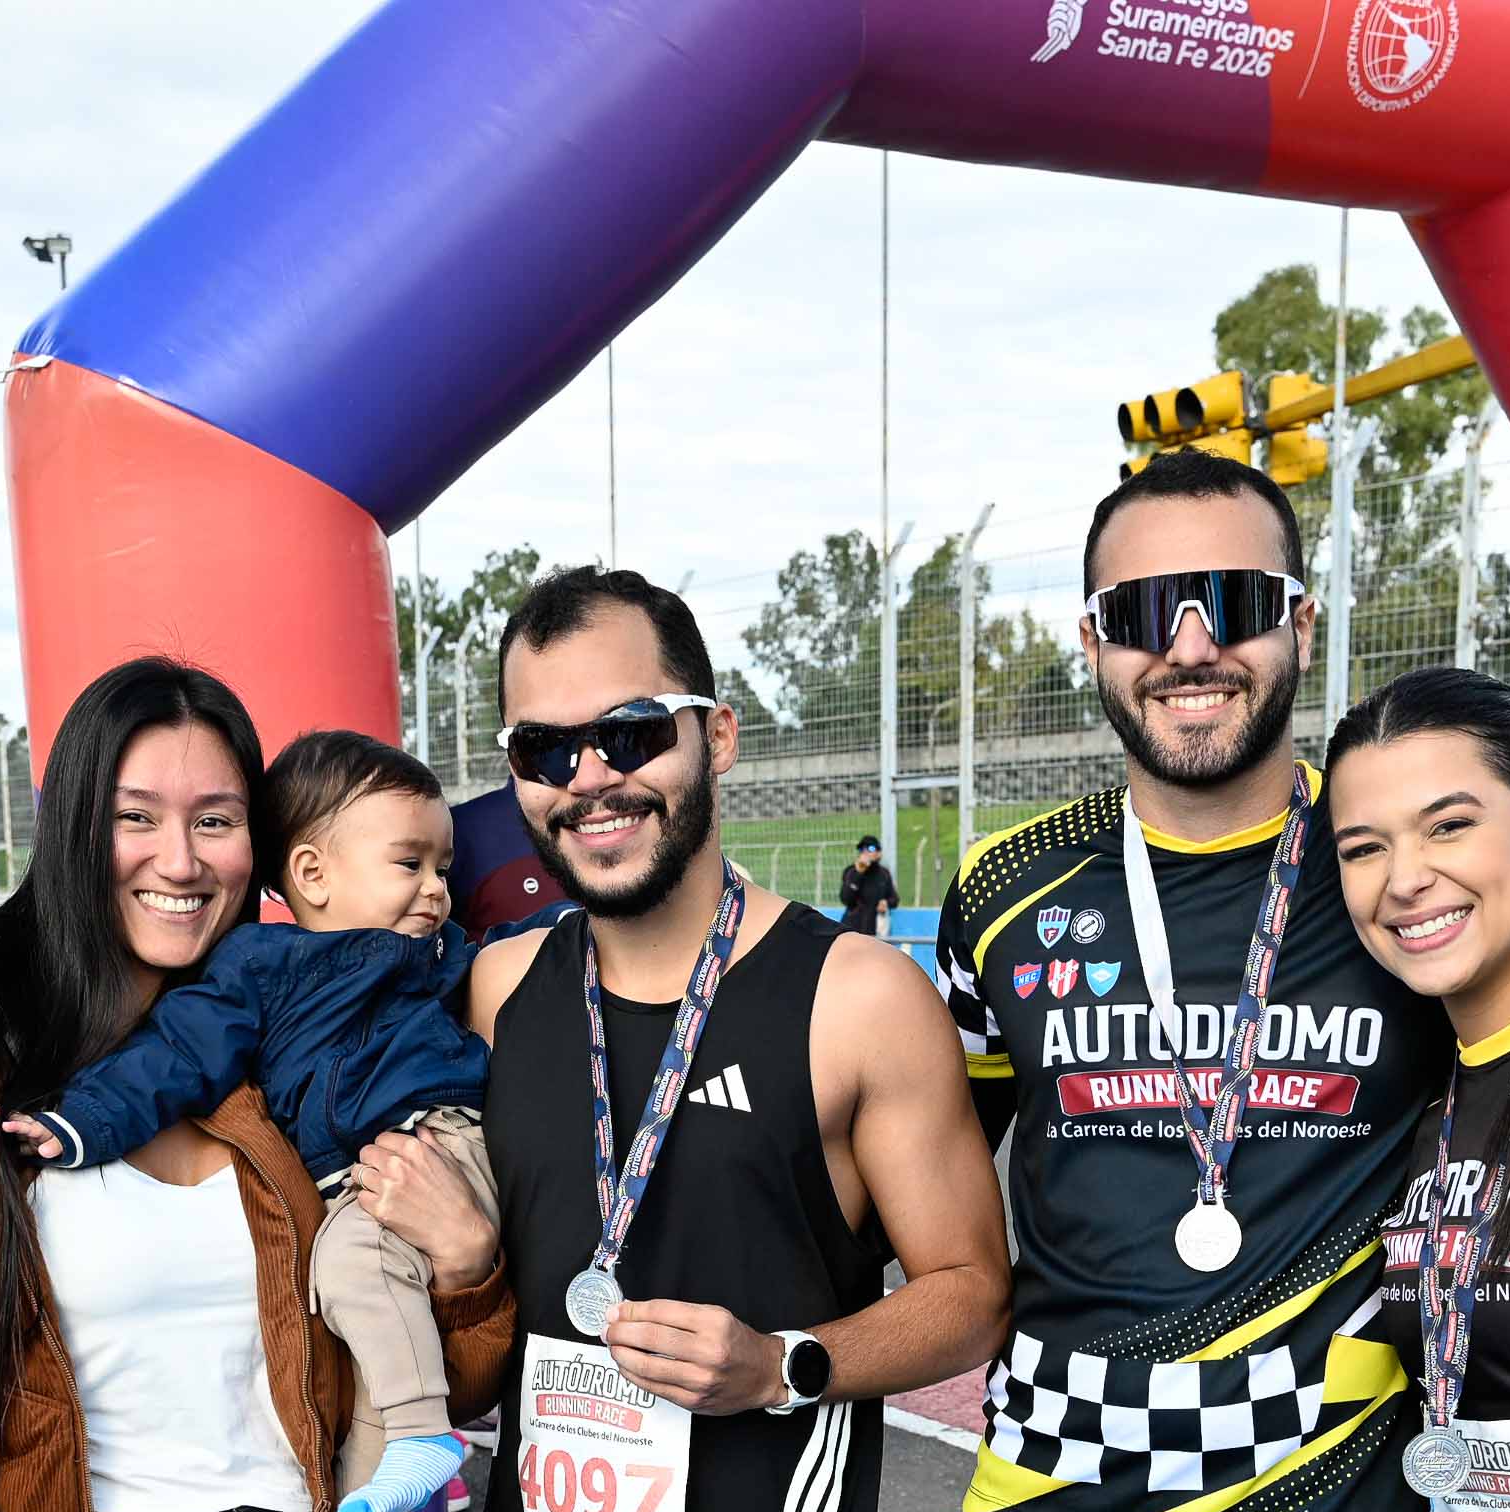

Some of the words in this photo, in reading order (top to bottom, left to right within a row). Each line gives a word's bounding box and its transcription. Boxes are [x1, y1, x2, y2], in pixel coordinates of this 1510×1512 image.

[1107, 0, 1294, 51] Suramericanos
[1098, 28, 1173, 64] Santa
[1175, 40, 1208, 68] Fe
[1210, 45, 1275, 77] 2026
[1043, 1003, 1383, 1068] AUTODOMO
[1089, 1075, 1223, 1108] RUNNNG
[1062, 1121, 1126, 1138] Carrera
[1131, 1121, 1153, 1138] de
[1158, 1123, 1185, 1138] los
[1258, 1121, 1288, 1138] del
[1293, 1121, 1371, 1139] Noroeste
[1390, 1284, 1400, 1301] de
[1402, 1285, 1416, 1302] los
[1475, 1284, 1490, 1302] el
[545, 1397, 591, 1416] RUNNING
[595, 1401, 626, 1426] RACE
[535, 1418, 556, 1433] Carrera
[557, 1422, 565, 1433] de
[566, 1424, 576, 1435] los
[577, 1426, 600, 1440] Clubes
[601, 1430, 612, 1441] del
[613, 1433, 653, 1447] Noroeste
[1443, 1496, 1470, 1506] Carrera
